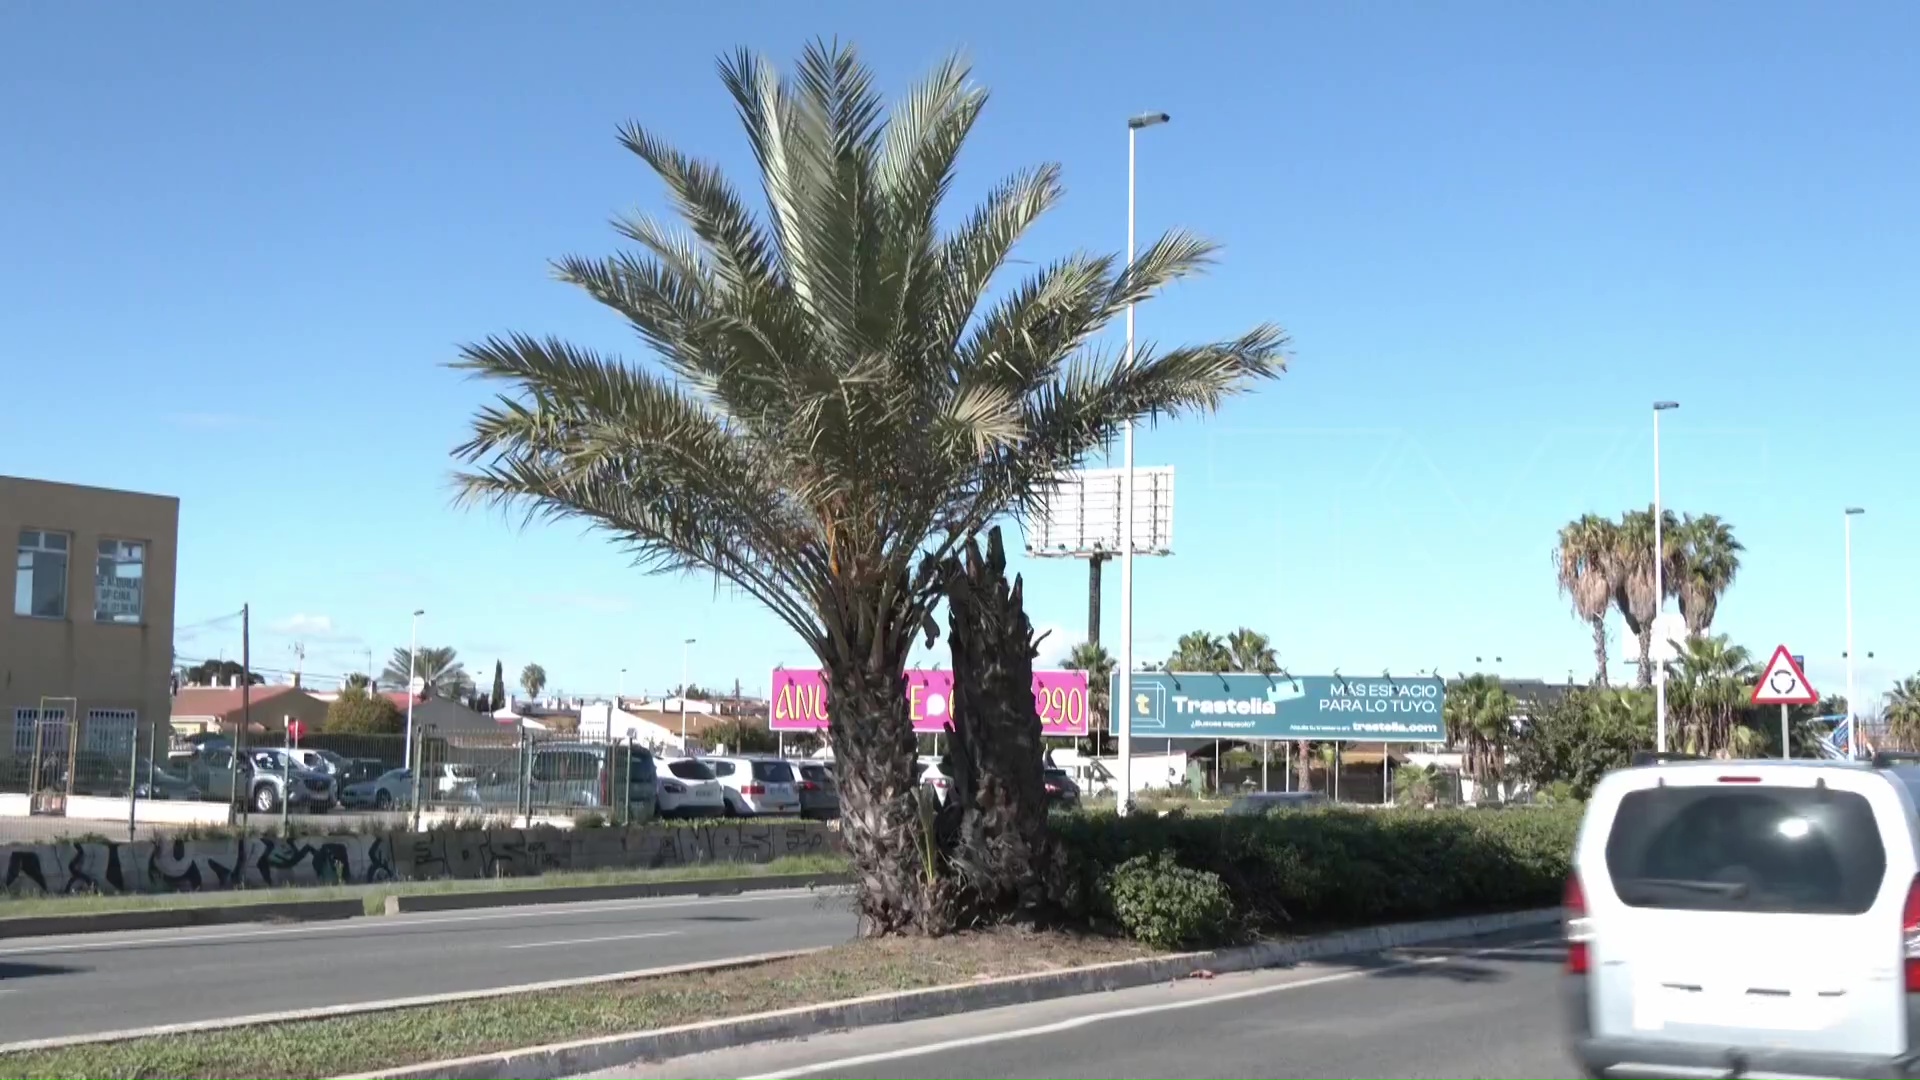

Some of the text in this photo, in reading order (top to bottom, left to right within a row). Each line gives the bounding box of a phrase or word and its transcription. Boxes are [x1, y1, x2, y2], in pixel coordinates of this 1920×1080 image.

[1330, 681, 1437, 698] MÁS ESPACIO
[1038, 687, 1083, 725] 290
[1135, 693, 1150, 715] t
[1319, 699, 1437, 713] PARA LO TUYO.
